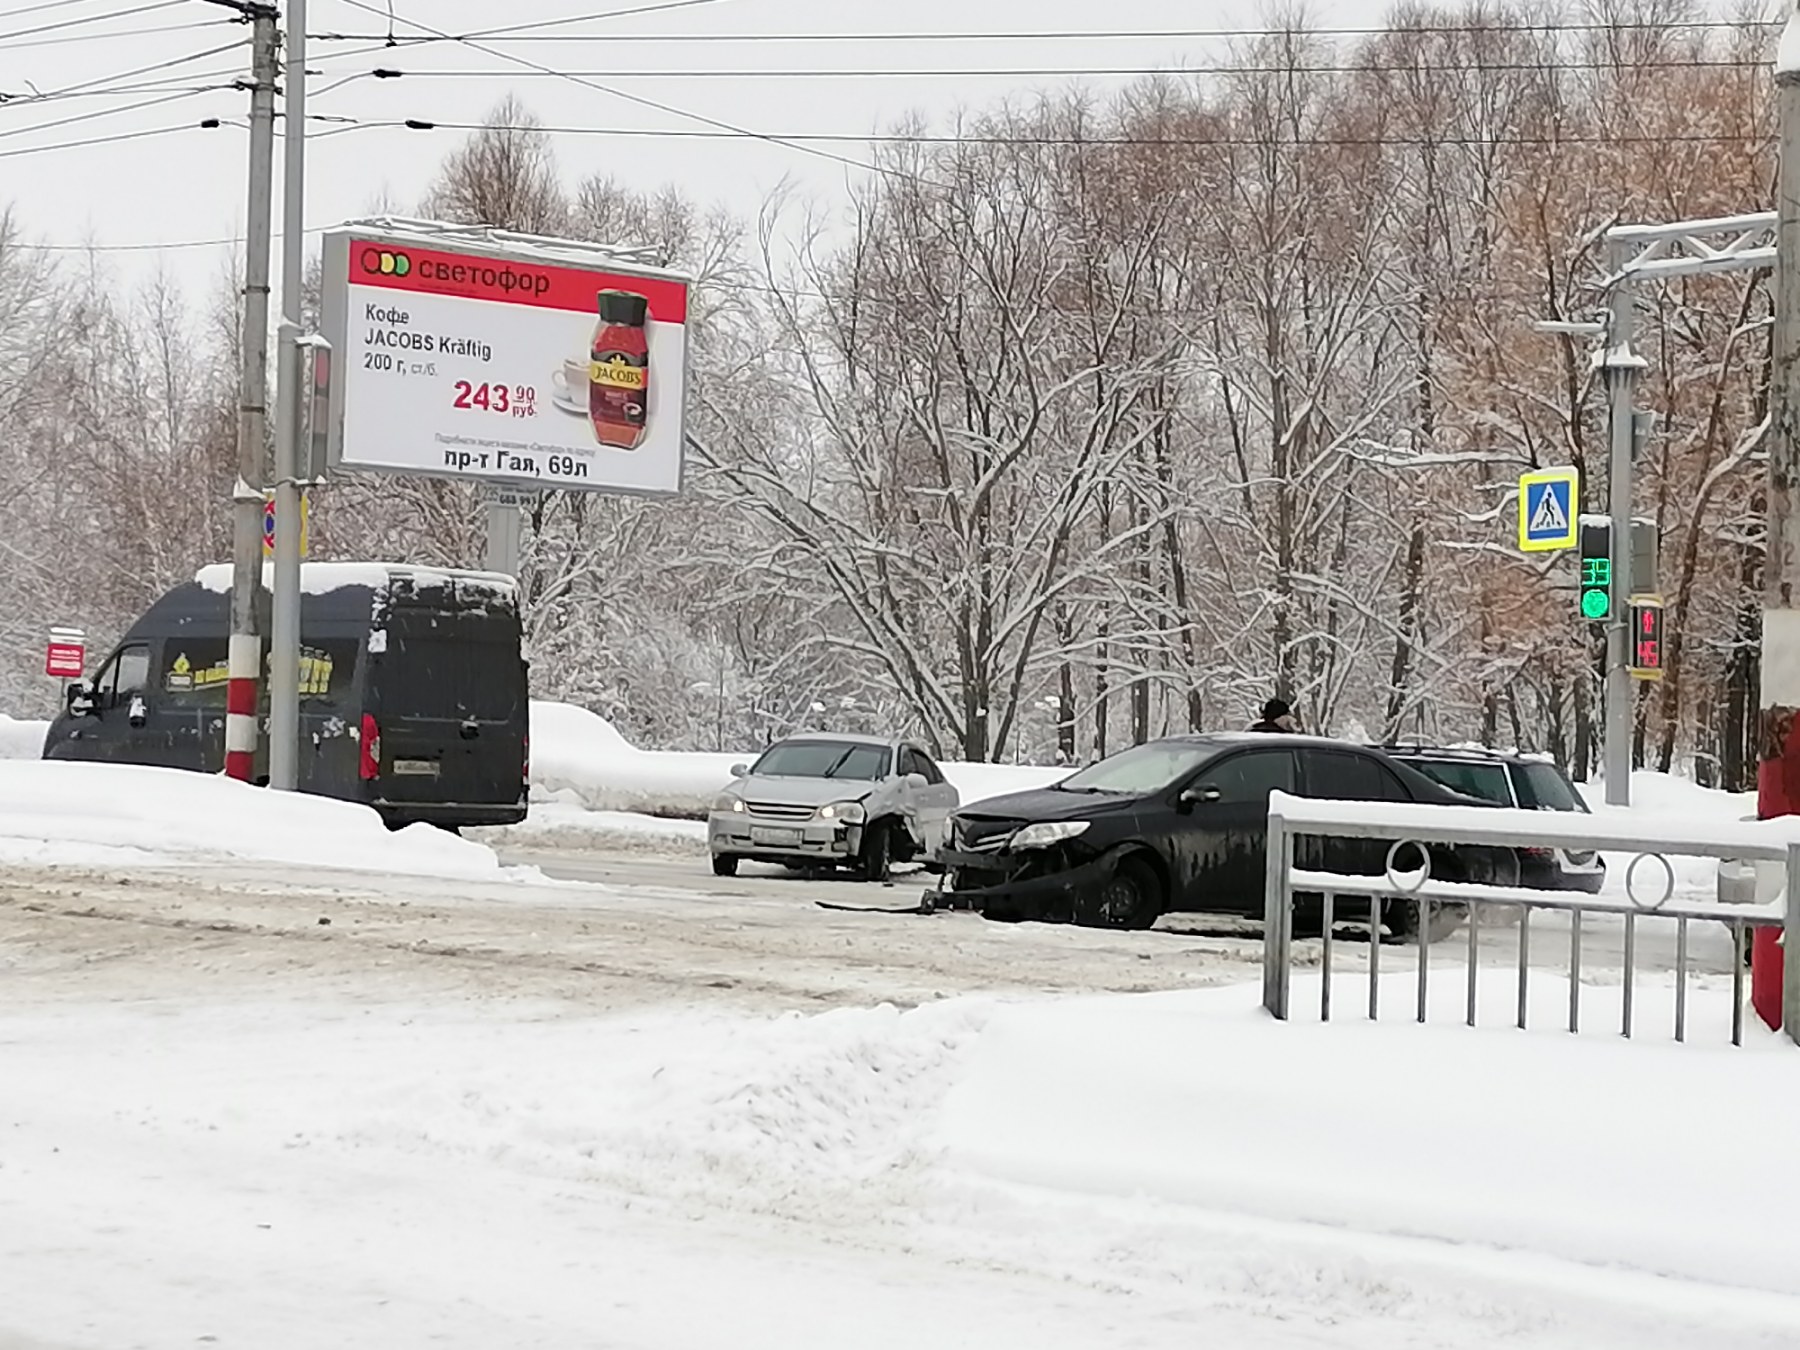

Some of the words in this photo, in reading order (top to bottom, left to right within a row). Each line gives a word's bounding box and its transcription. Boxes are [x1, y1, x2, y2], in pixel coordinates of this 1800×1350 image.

[419, 260, 550, 297] светофор
[366, 303, 410, 326] Кофе
[365, 328, 434, 351] JACOBS
[439, 337, 492, 362] Kräftig
[364, 352, 392, 371] 200
[594, 366, 642, 385] JACOBS
[453, 380, 509, 413] 243
[445, 450, 489, 471] пр-т
[549, 455, 588, 478] 69л
[1581, 558, 1610, 585] 39
[1637, 640, 1658, 667] 45
